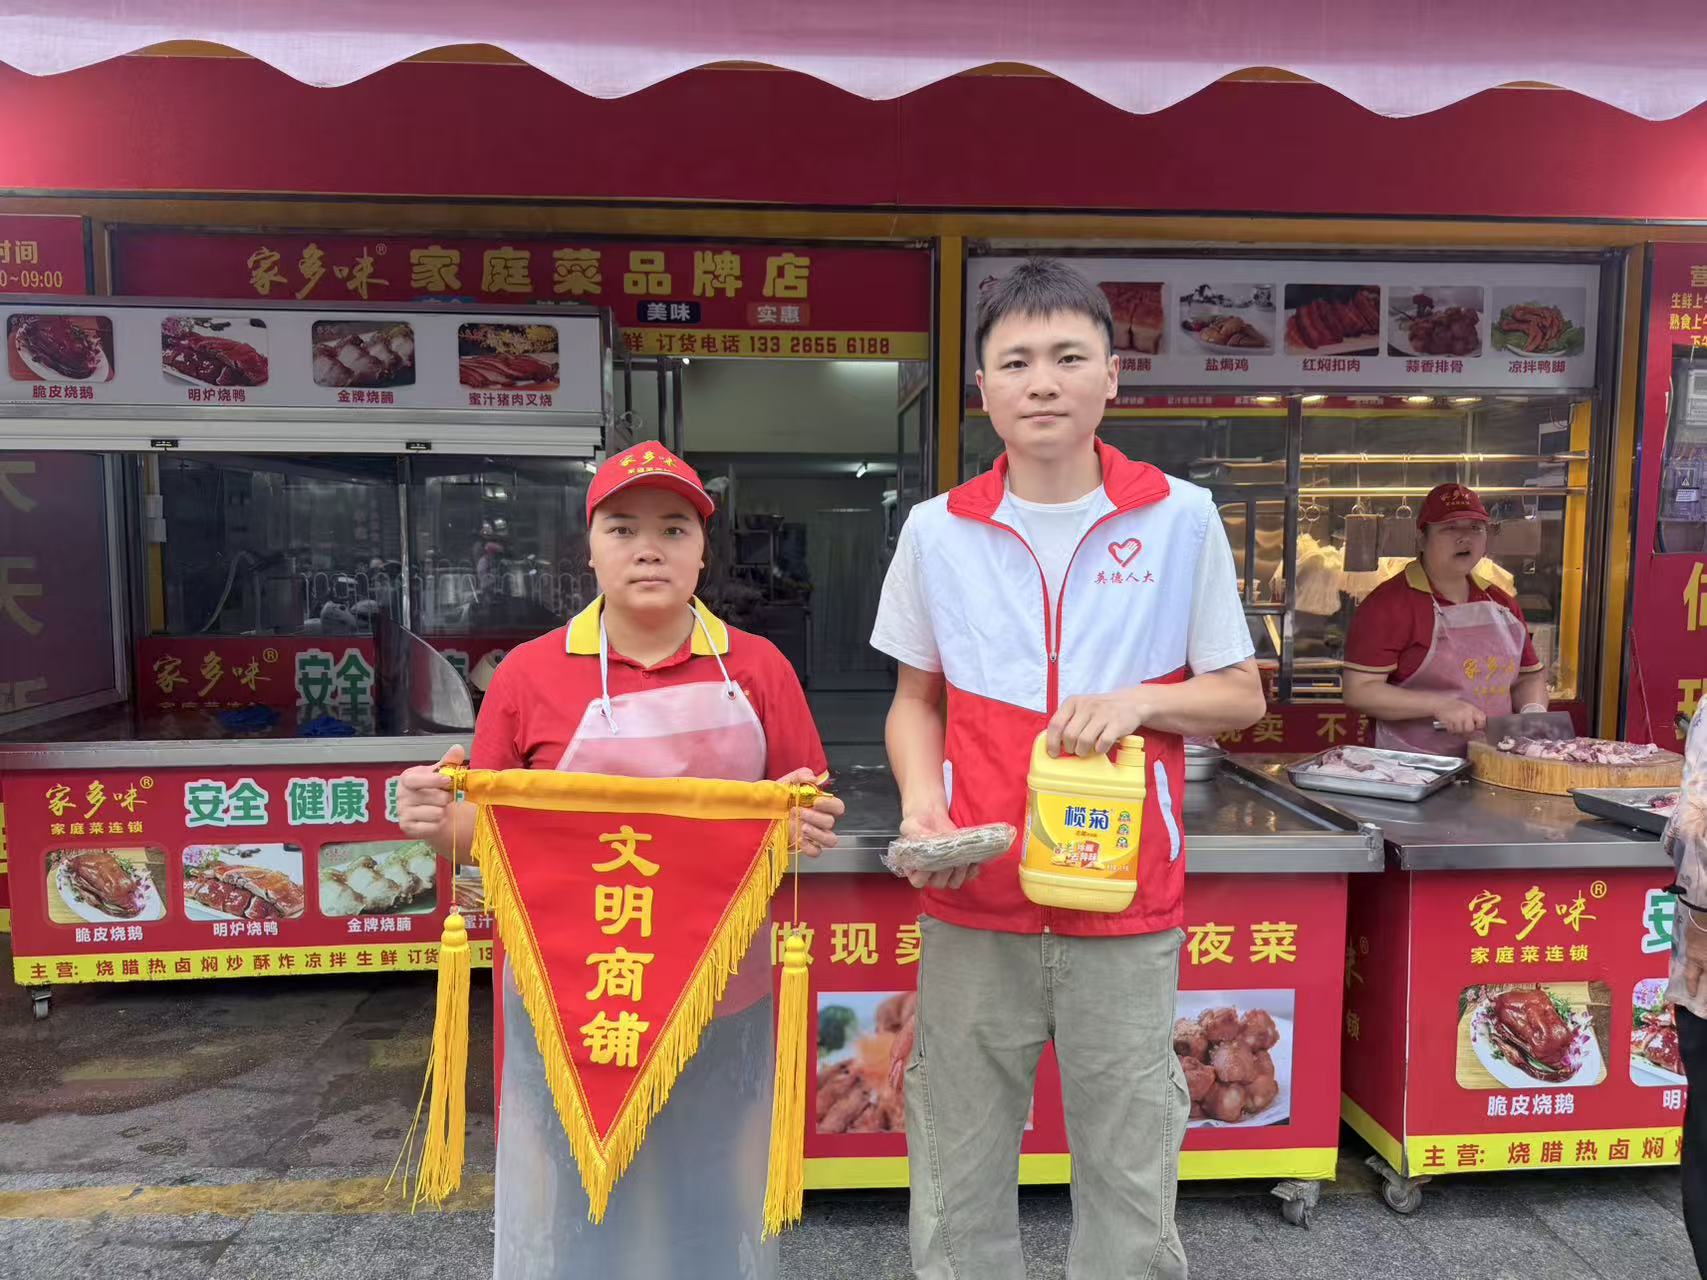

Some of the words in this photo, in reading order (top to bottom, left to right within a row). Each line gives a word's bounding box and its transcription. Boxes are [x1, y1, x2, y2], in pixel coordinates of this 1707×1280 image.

[247, 243, 389, 299] 家多味
[410, 246, 811, 298] 家庭菜品牌店
[1671, 292, 1707, 308] 生鲜上
[646, 302, 691, 321] 美味
[757, 305, 800, 323] 实惠
[656, 333, 740, 353] 订货电话
[750, 336, 780, 353] 133
[790, 336, 837, 353] 2655
[846, 337, 890, 354] 6188
[1119, 357, 1152, 371] 烧腩
[1205, 357, 1249, 372] 盐焗鸡
[1302, 358, 1361, 372] 红焖扣肉
[1406, 359, 1464, 374] 蒜香排骨
[1508, 360, 1566, 374] 凉拌鸭脚
[33, 385, 94, 400] 脆皮烧鹅
[188, 389, 246, 402] 明炉烧鸭
[469, 393, 553, 407] 蜜汁猪肉叉烧
[1094, 570, 1154, 584] 英德人大
[153, 651, 271, 697] 家多味
[295, 648, 375, 705] 安全
[45, 780, 147, 819] 家多味
[184, 778, 268, 827] 安全
[288, 777, 369, 825] 健康
[1064, 805, 1111, 830] 榄菊
[51, 821, 143, 835] 家庭菜连锁
[1467, 885, 1597, 941] 家多味
[75, 926, 144, 943] 脆皮烧鹅
[213, 922, 279, 937] 明炉烧鸭
[580, 825, 660, 1067] 文明商铺
[1186, 921, 1298, 965] 夜菜
[1470, 946, 1589, 964] 家庭菜连锁
[1486, 1094, 1575, 1117] 脆皮烧鹅
[1663, 1089, 1687, 1110] 明
